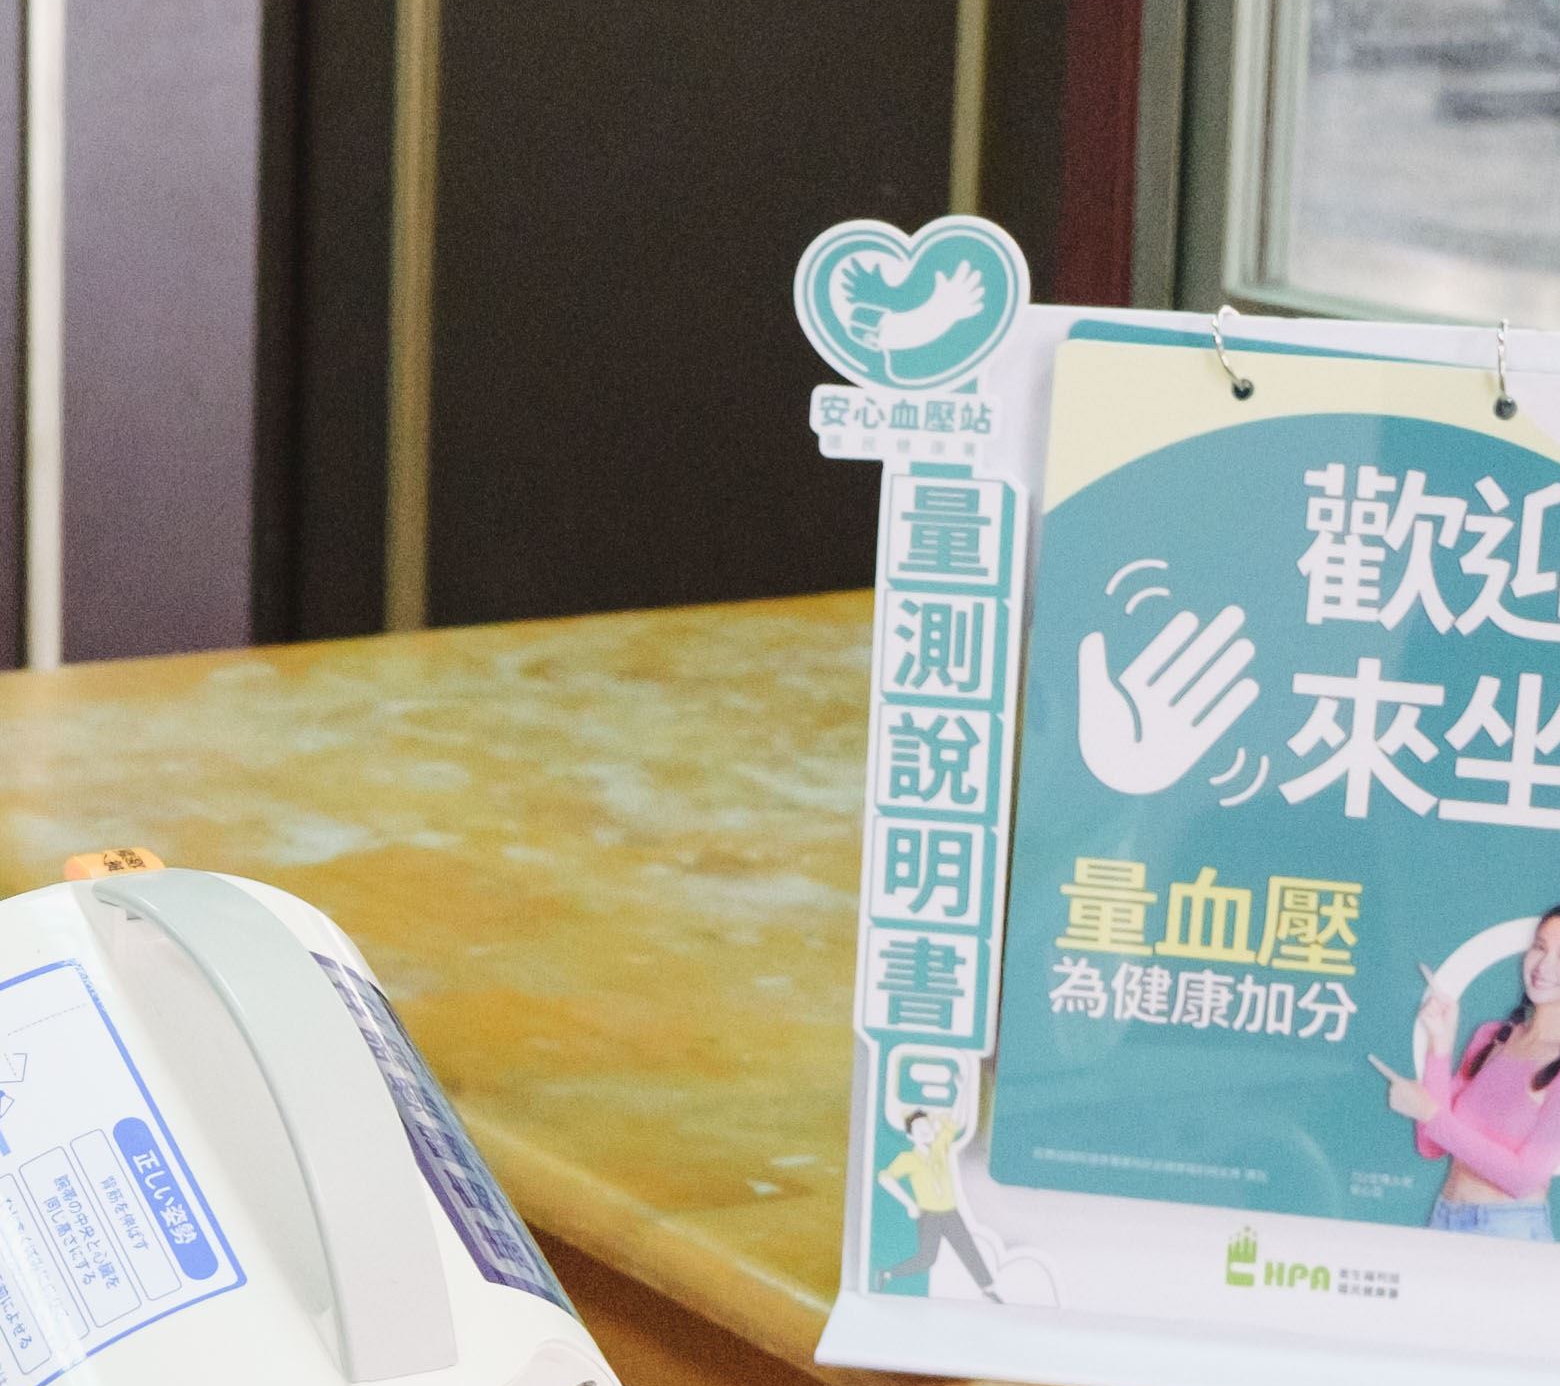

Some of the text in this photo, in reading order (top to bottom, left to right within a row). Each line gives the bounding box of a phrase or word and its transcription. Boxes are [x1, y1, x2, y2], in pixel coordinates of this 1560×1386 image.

[819, 395, 993, 433] 安心血壓站
[877, 485, 992, 1031] 量測說明書
[1055, 857, 1363, 976] 量血壓
[1049, 959, 1358, 1042] 為健康加分
[43, 1197, 93, 1285] 同じ高さにする
[100, 1175, 149, 1251] 背筋を伸ばす
[133, 1149, 198, 1245] 正しい姿勢
